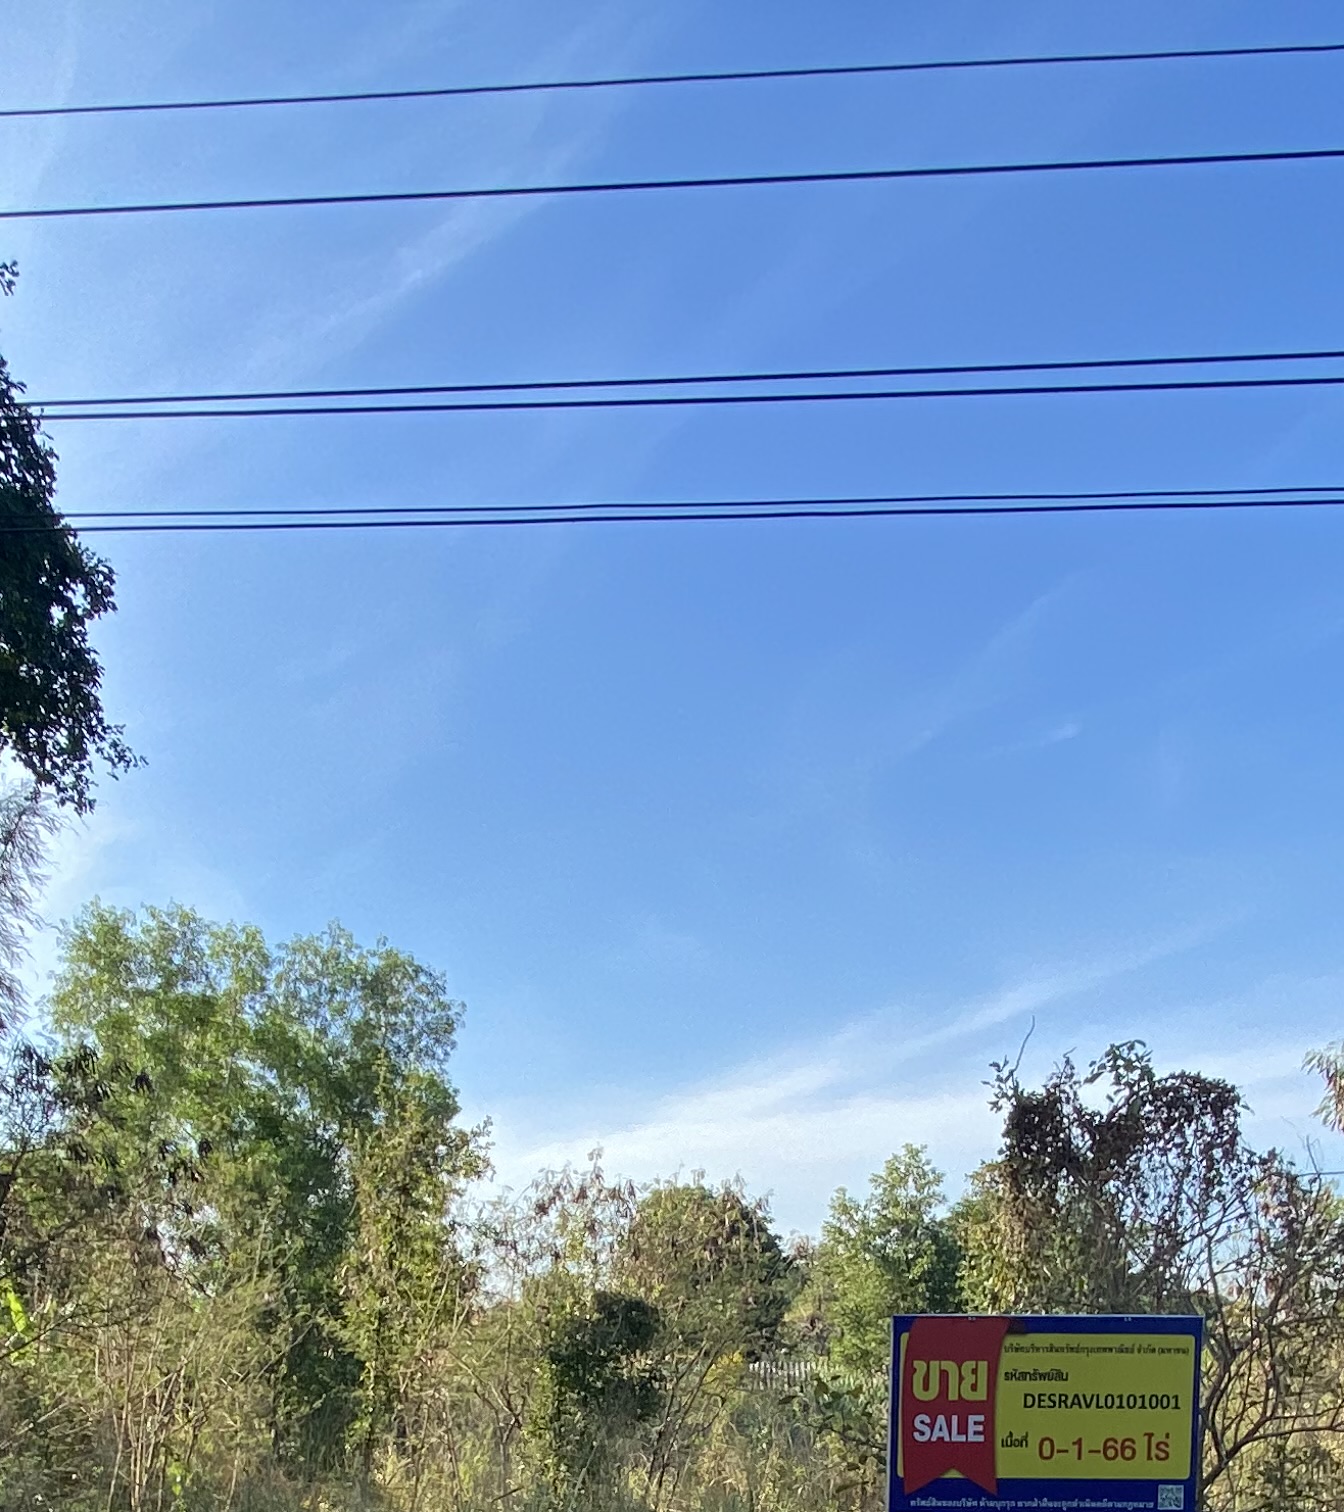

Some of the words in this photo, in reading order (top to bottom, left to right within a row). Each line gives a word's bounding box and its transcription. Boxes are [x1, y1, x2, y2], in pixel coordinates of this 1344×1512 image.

[912, 1360, 988, 1401] ขาย
[1023, 1393, 1181, 1410] DESRAVL0101001
[912, 1413, 985, 1443] SALE
[1001, 1431, 1029, 1449] เนื้อที่
[1038, 1436, 1137, 1461] 0-1-66
[1143, 1432, 1170, 1461] ไร่
